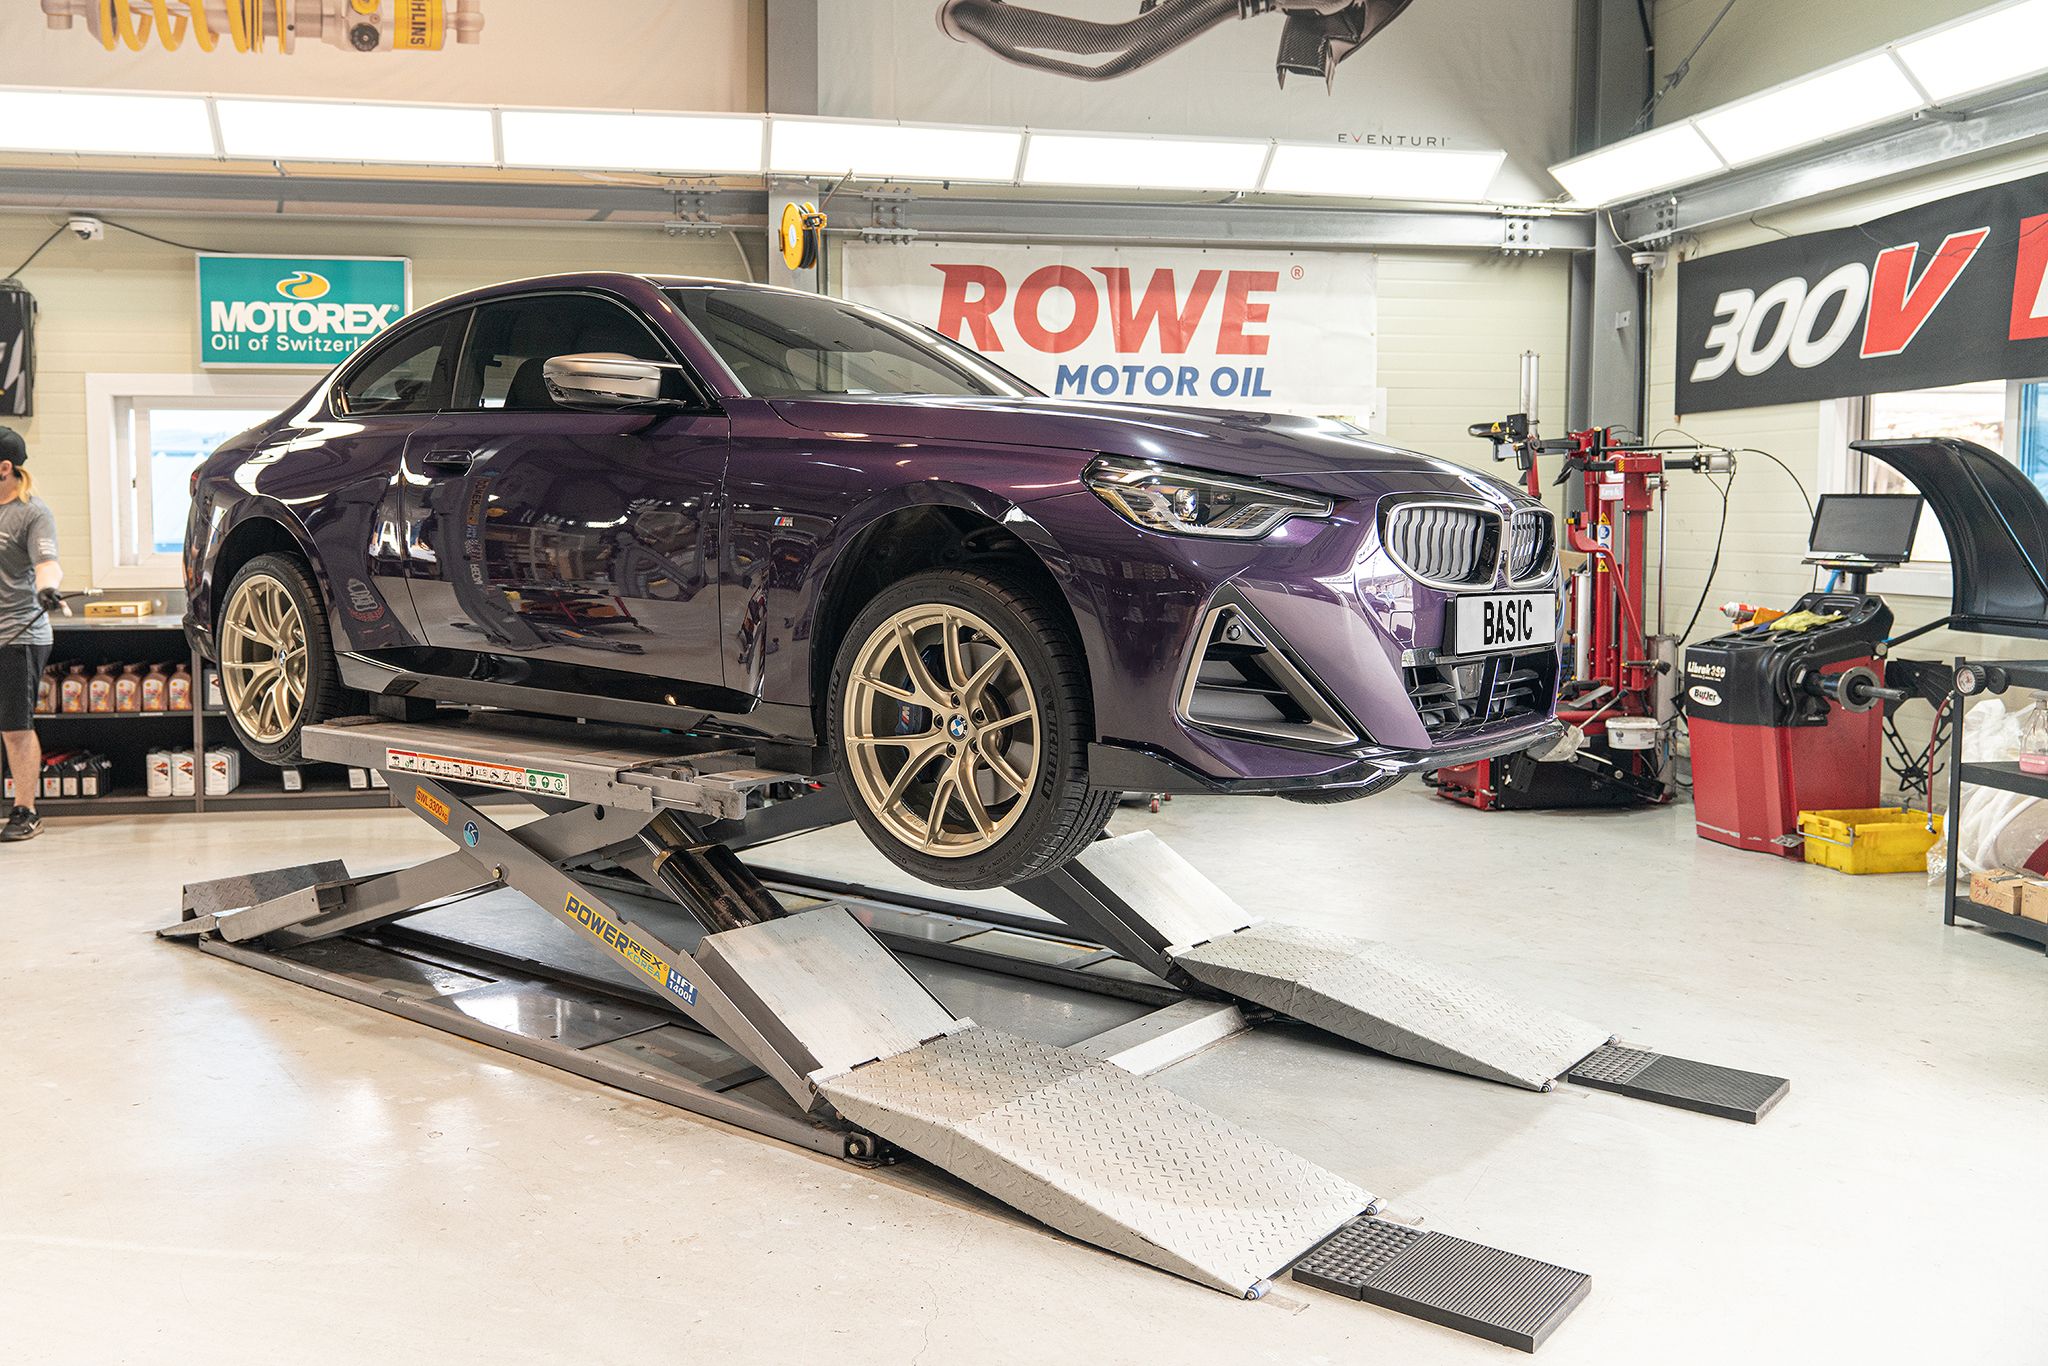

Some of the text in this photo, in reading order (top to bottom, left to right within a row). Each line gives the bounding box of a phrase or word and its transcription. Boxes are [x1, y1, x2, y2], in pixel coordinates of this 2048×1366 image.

[411, 0, 426, 45] HLINS
[1337, 130, 1446, 147] EVENTURI
[210, 301, 393, 334] MOTOREX
[930, 263, 1281, 355] ROWE
[1690, 225, 1990, 383] 300V
[211, 334, 366, 352] Oil of Switzerl
[1054, 364, 1273, 398] MOTOR OIL
[1484, 599, 1533, 645] BASIC
[668, 980, 693, 1004] 1400L
[669, 970, 698, 993] LIFT
